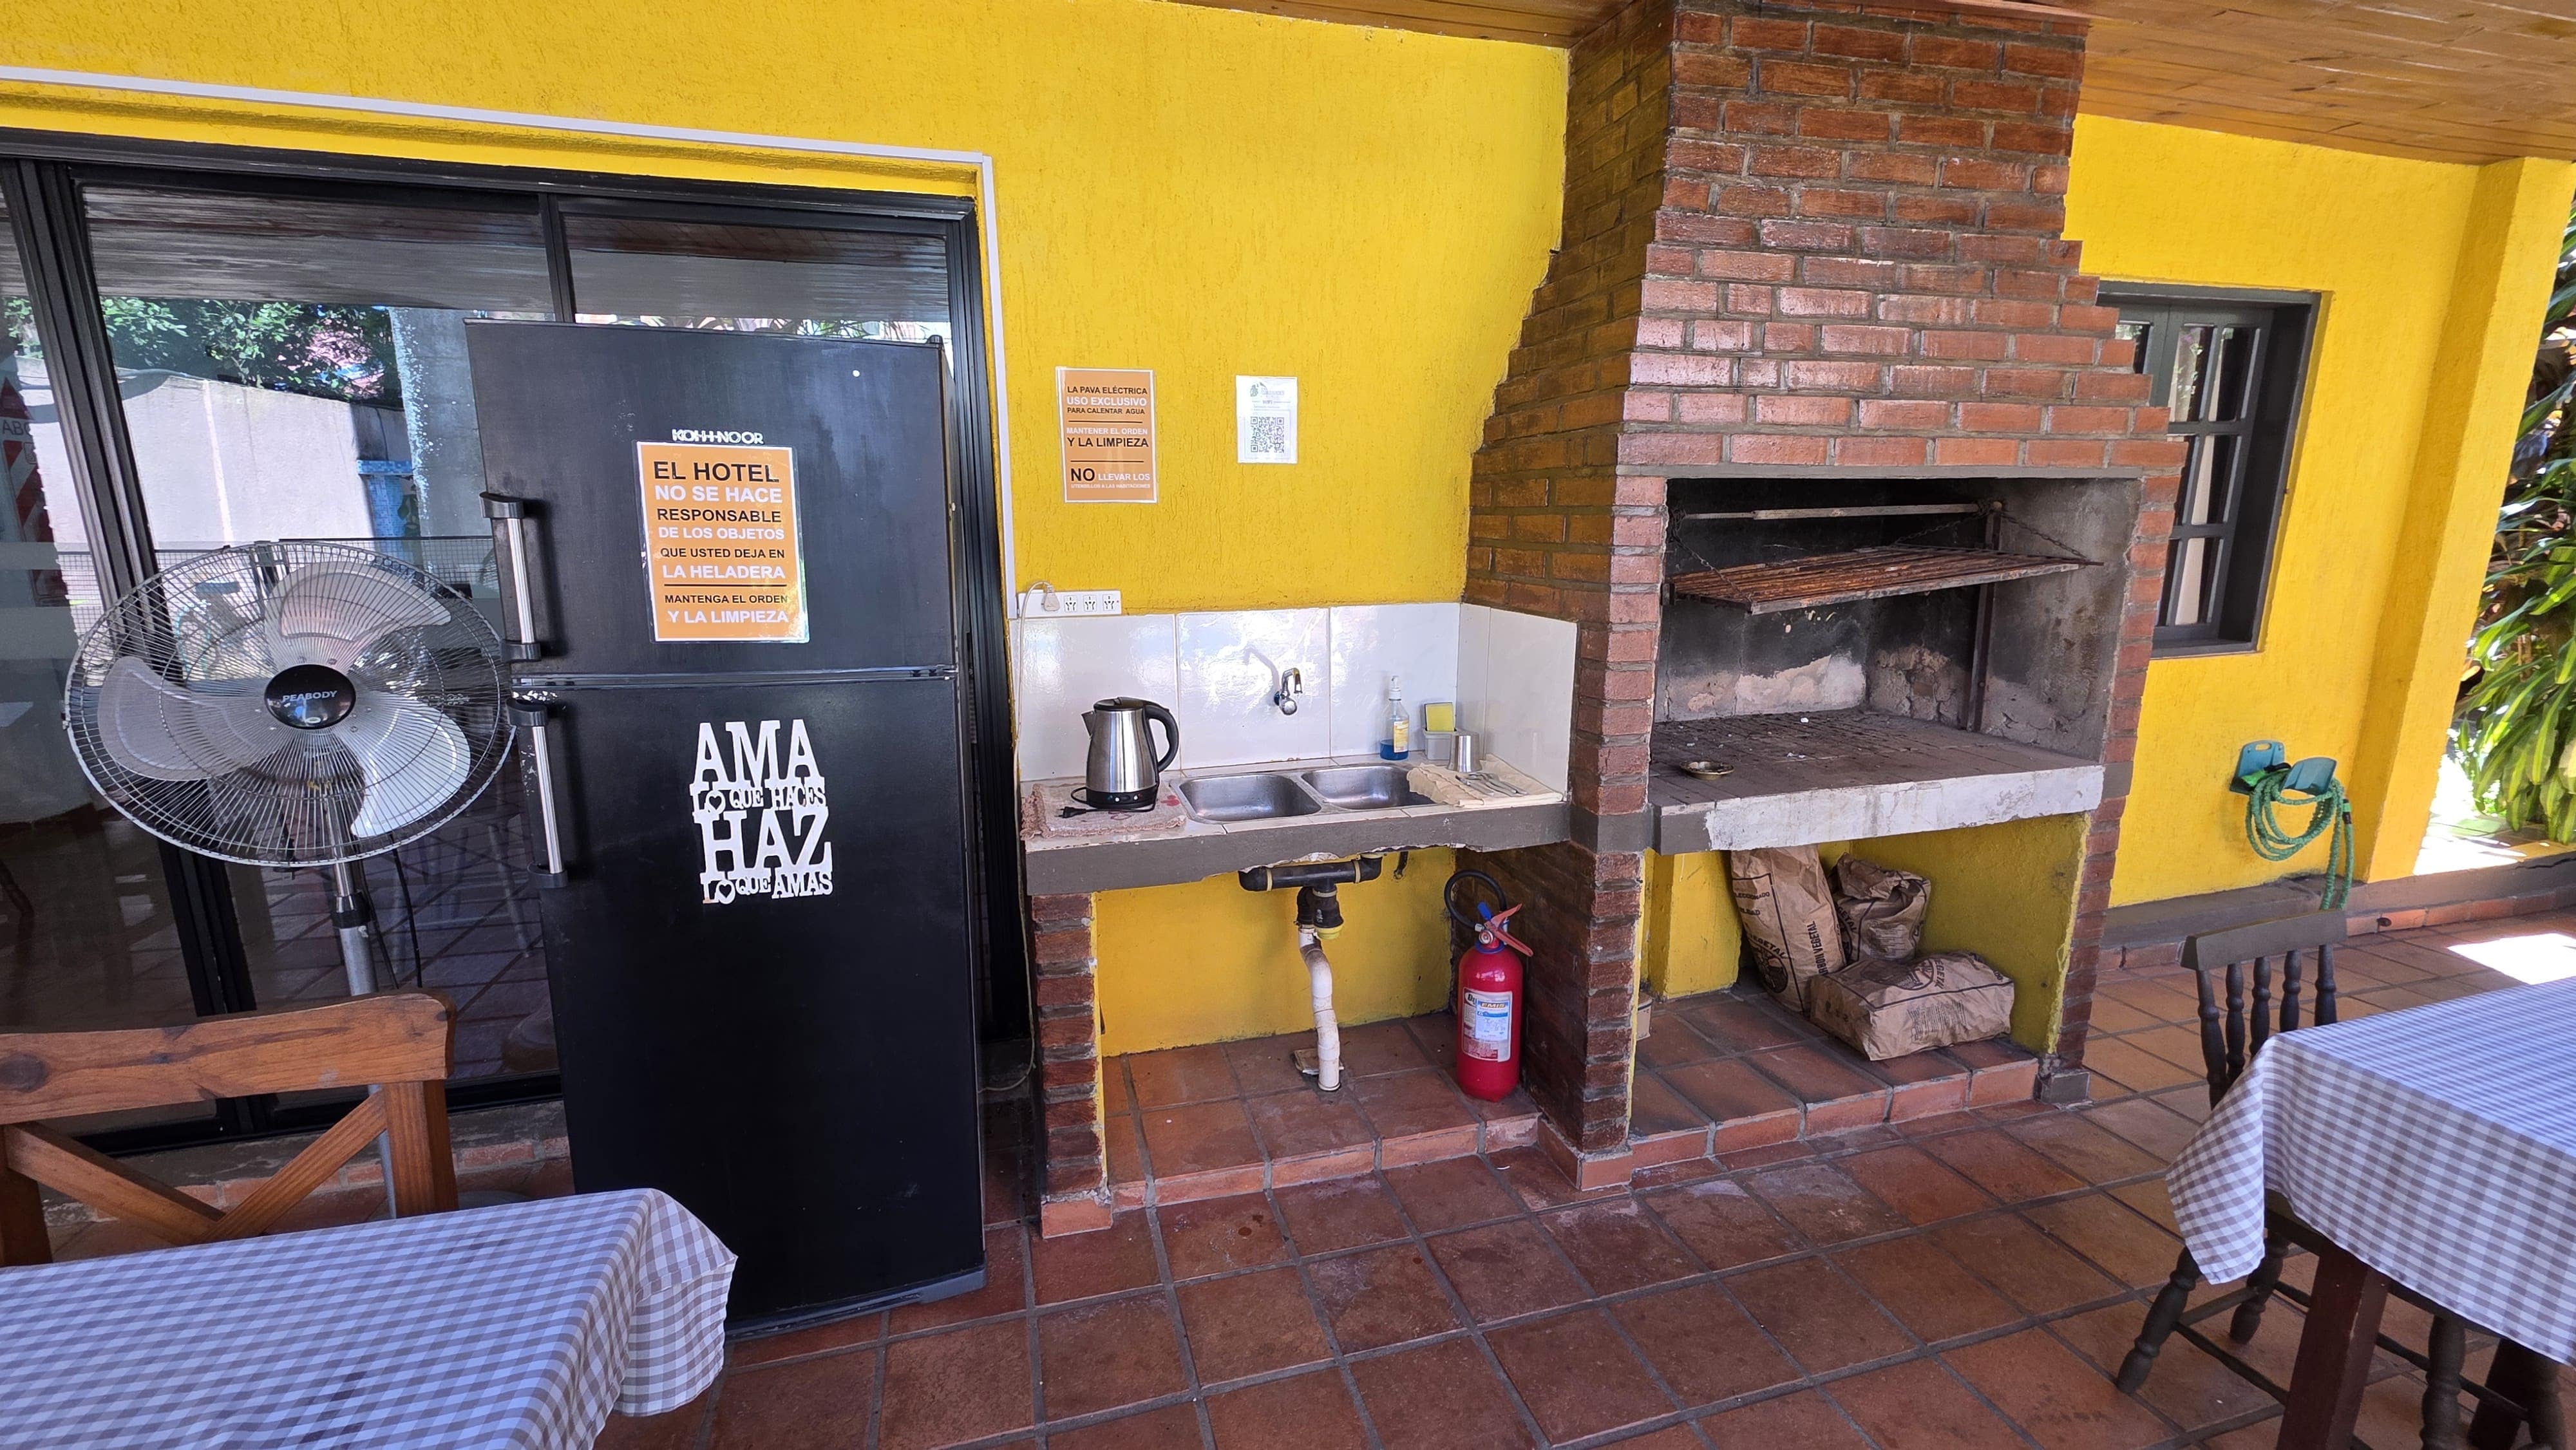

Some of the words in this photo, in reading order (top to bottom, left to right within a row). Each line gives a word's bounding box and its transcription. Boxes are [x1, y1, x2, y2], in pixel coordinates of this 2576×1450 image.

[1066, 397, 1088, 405] USO
[1091, 397, 1147, 406] EXCLUSIVO
[1067, 437, 1075, 446] Y
[1078, 438, 1093, 447] LA
[1096, 438, 1149, 447] LIMPIEZA
[654, 461, 687, 480] EL
[694, 462, 779, 483] HOTEL
[1071, 468, 1095, 482] NO
[655, 485, 687, 501] NO
[692, 485, 719, 502] SE
[725, 487, 783, 504] HACE
[657, 508, 782, 523] RESPONSABLE
[658, 527, 679, 538] DE
[683, 527, 713, 539] LOS
[716, 527, 785, 540] OBJETOS
[660, 548, 687, 558] QUE
[690, 549, 731, 558] USTED
[734, 549, 766, 558] DEJA
[769, 549, 785, 558] EN
[662, 565, 687, 578] LA
[690, 565, 786, 579] HELADERA
[665, 595, 730, 603] MANTENGA
[732, 595, 746, 603] EL
[749, 595, 788, 603] ORDEN
[667, 611, 680, 623] Y
[684, 611, 707, 623] LA
[711, 611, 789, 623] LIMPIEZA
[281, 690, 337, 702] PEABODY
[690, 719, 824, 789] AMA
[729, 787, 764, 809] QUE
[771, 784, 826, 810] HACES
[692, 807, 833, 880] HAZ
[735, 876, 772, 896] QUE
[771, 871, 833, 899] AMAS
[1806, 921, 1823, 954] VEGETAL
